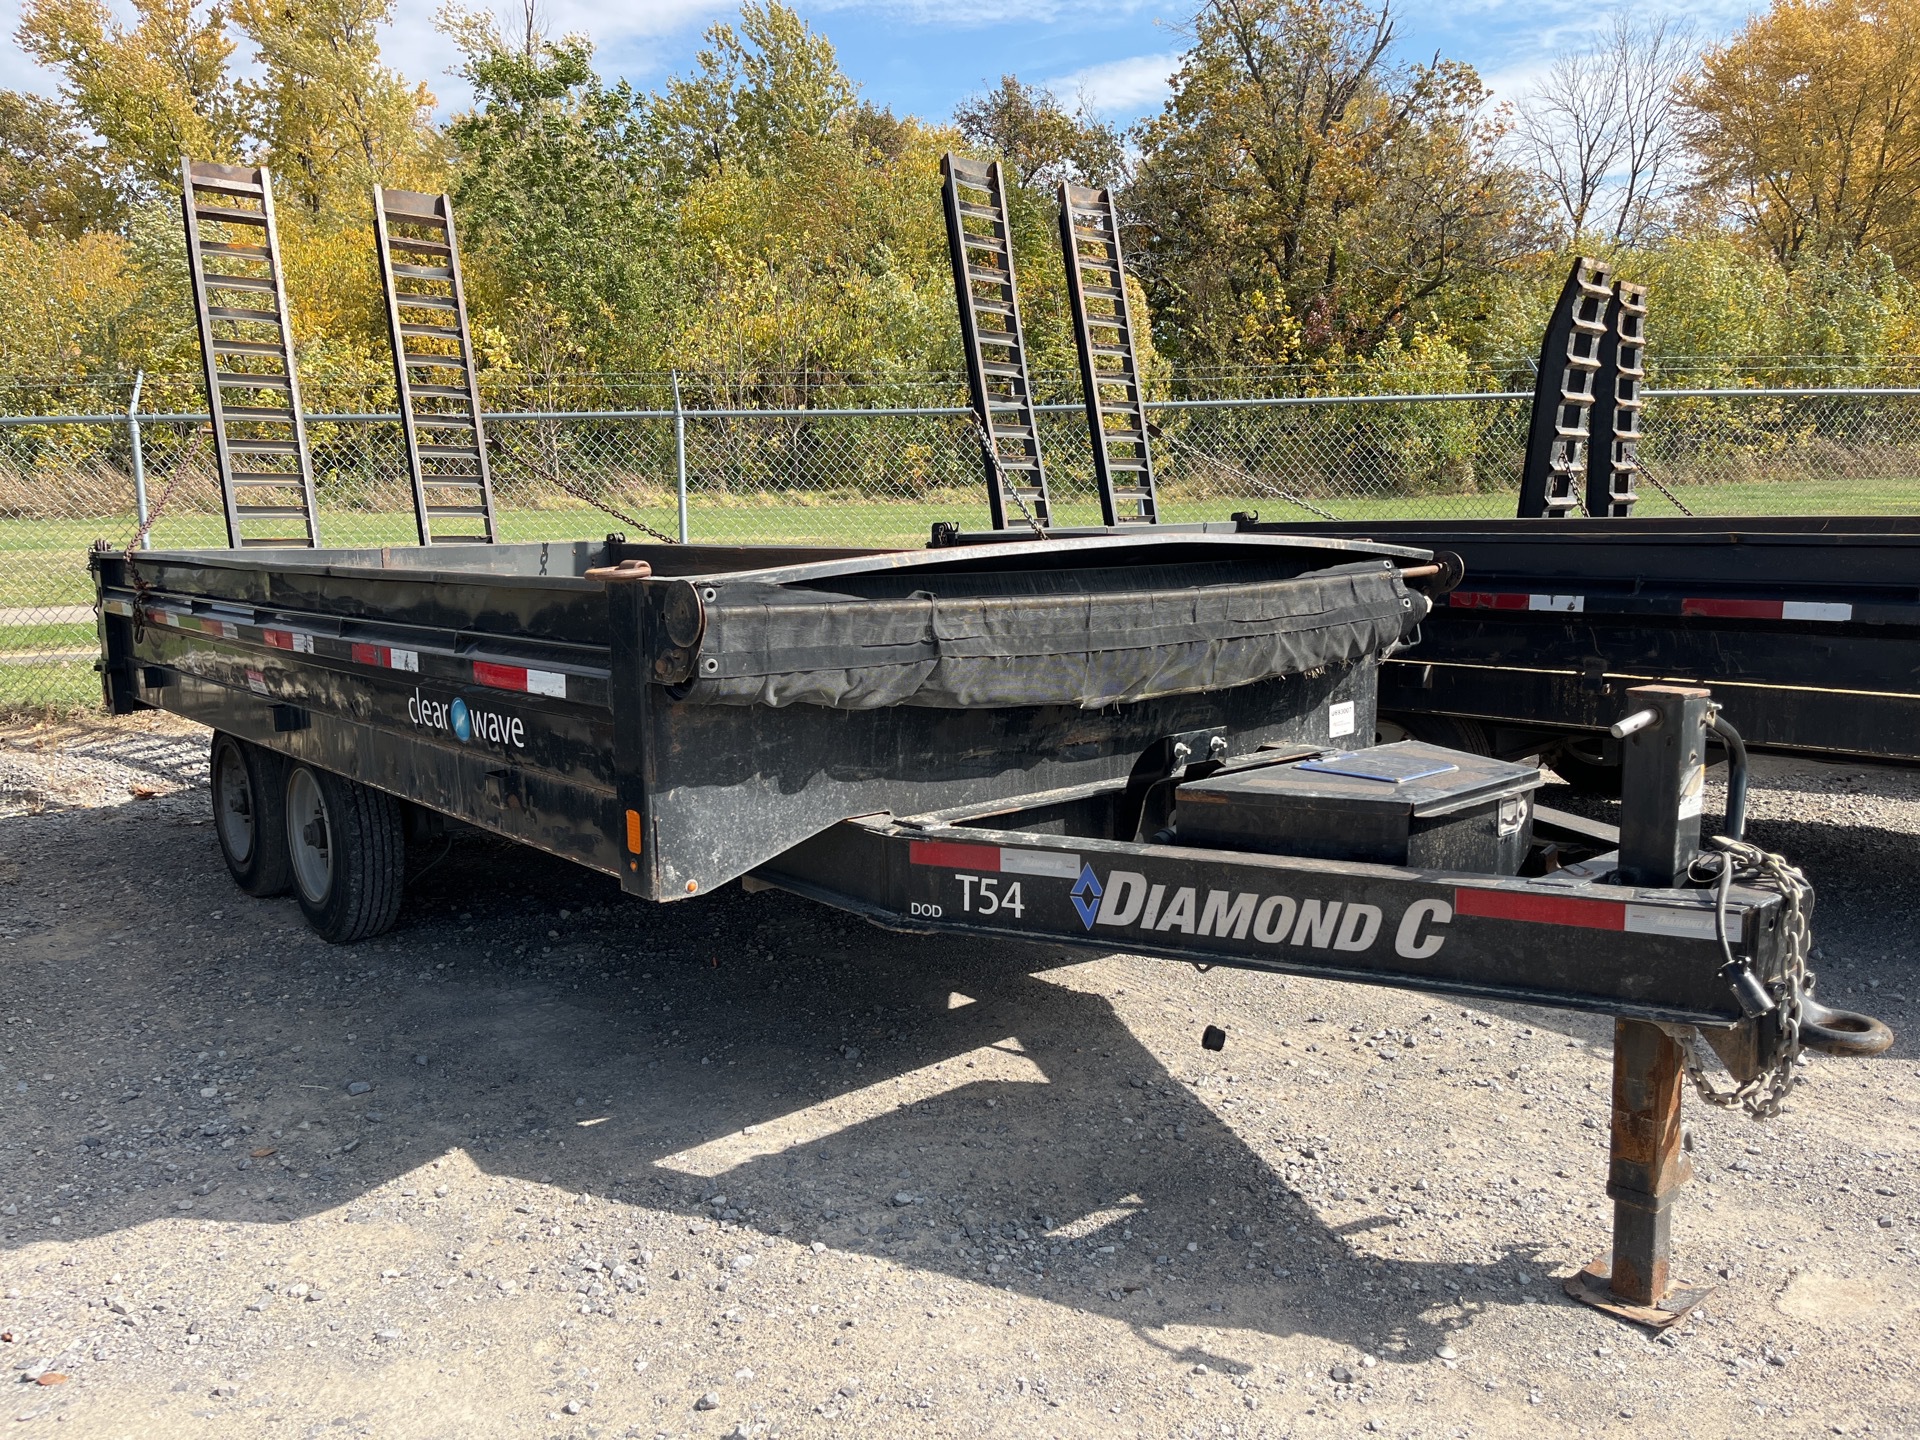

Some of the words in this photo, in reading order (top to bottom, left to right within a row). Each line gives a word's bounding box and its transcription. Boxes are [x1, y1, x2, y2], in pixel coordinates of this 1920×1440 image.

[408, 687, 448, 730] clear
[470, 709, 525, 748] wave
[910, 902, 943, 918] DOD
[954, 873, 1026, 919] T54
[1095, 869, 1383, 952] DIAMOND
[1394, 898, 1453, 960] C
